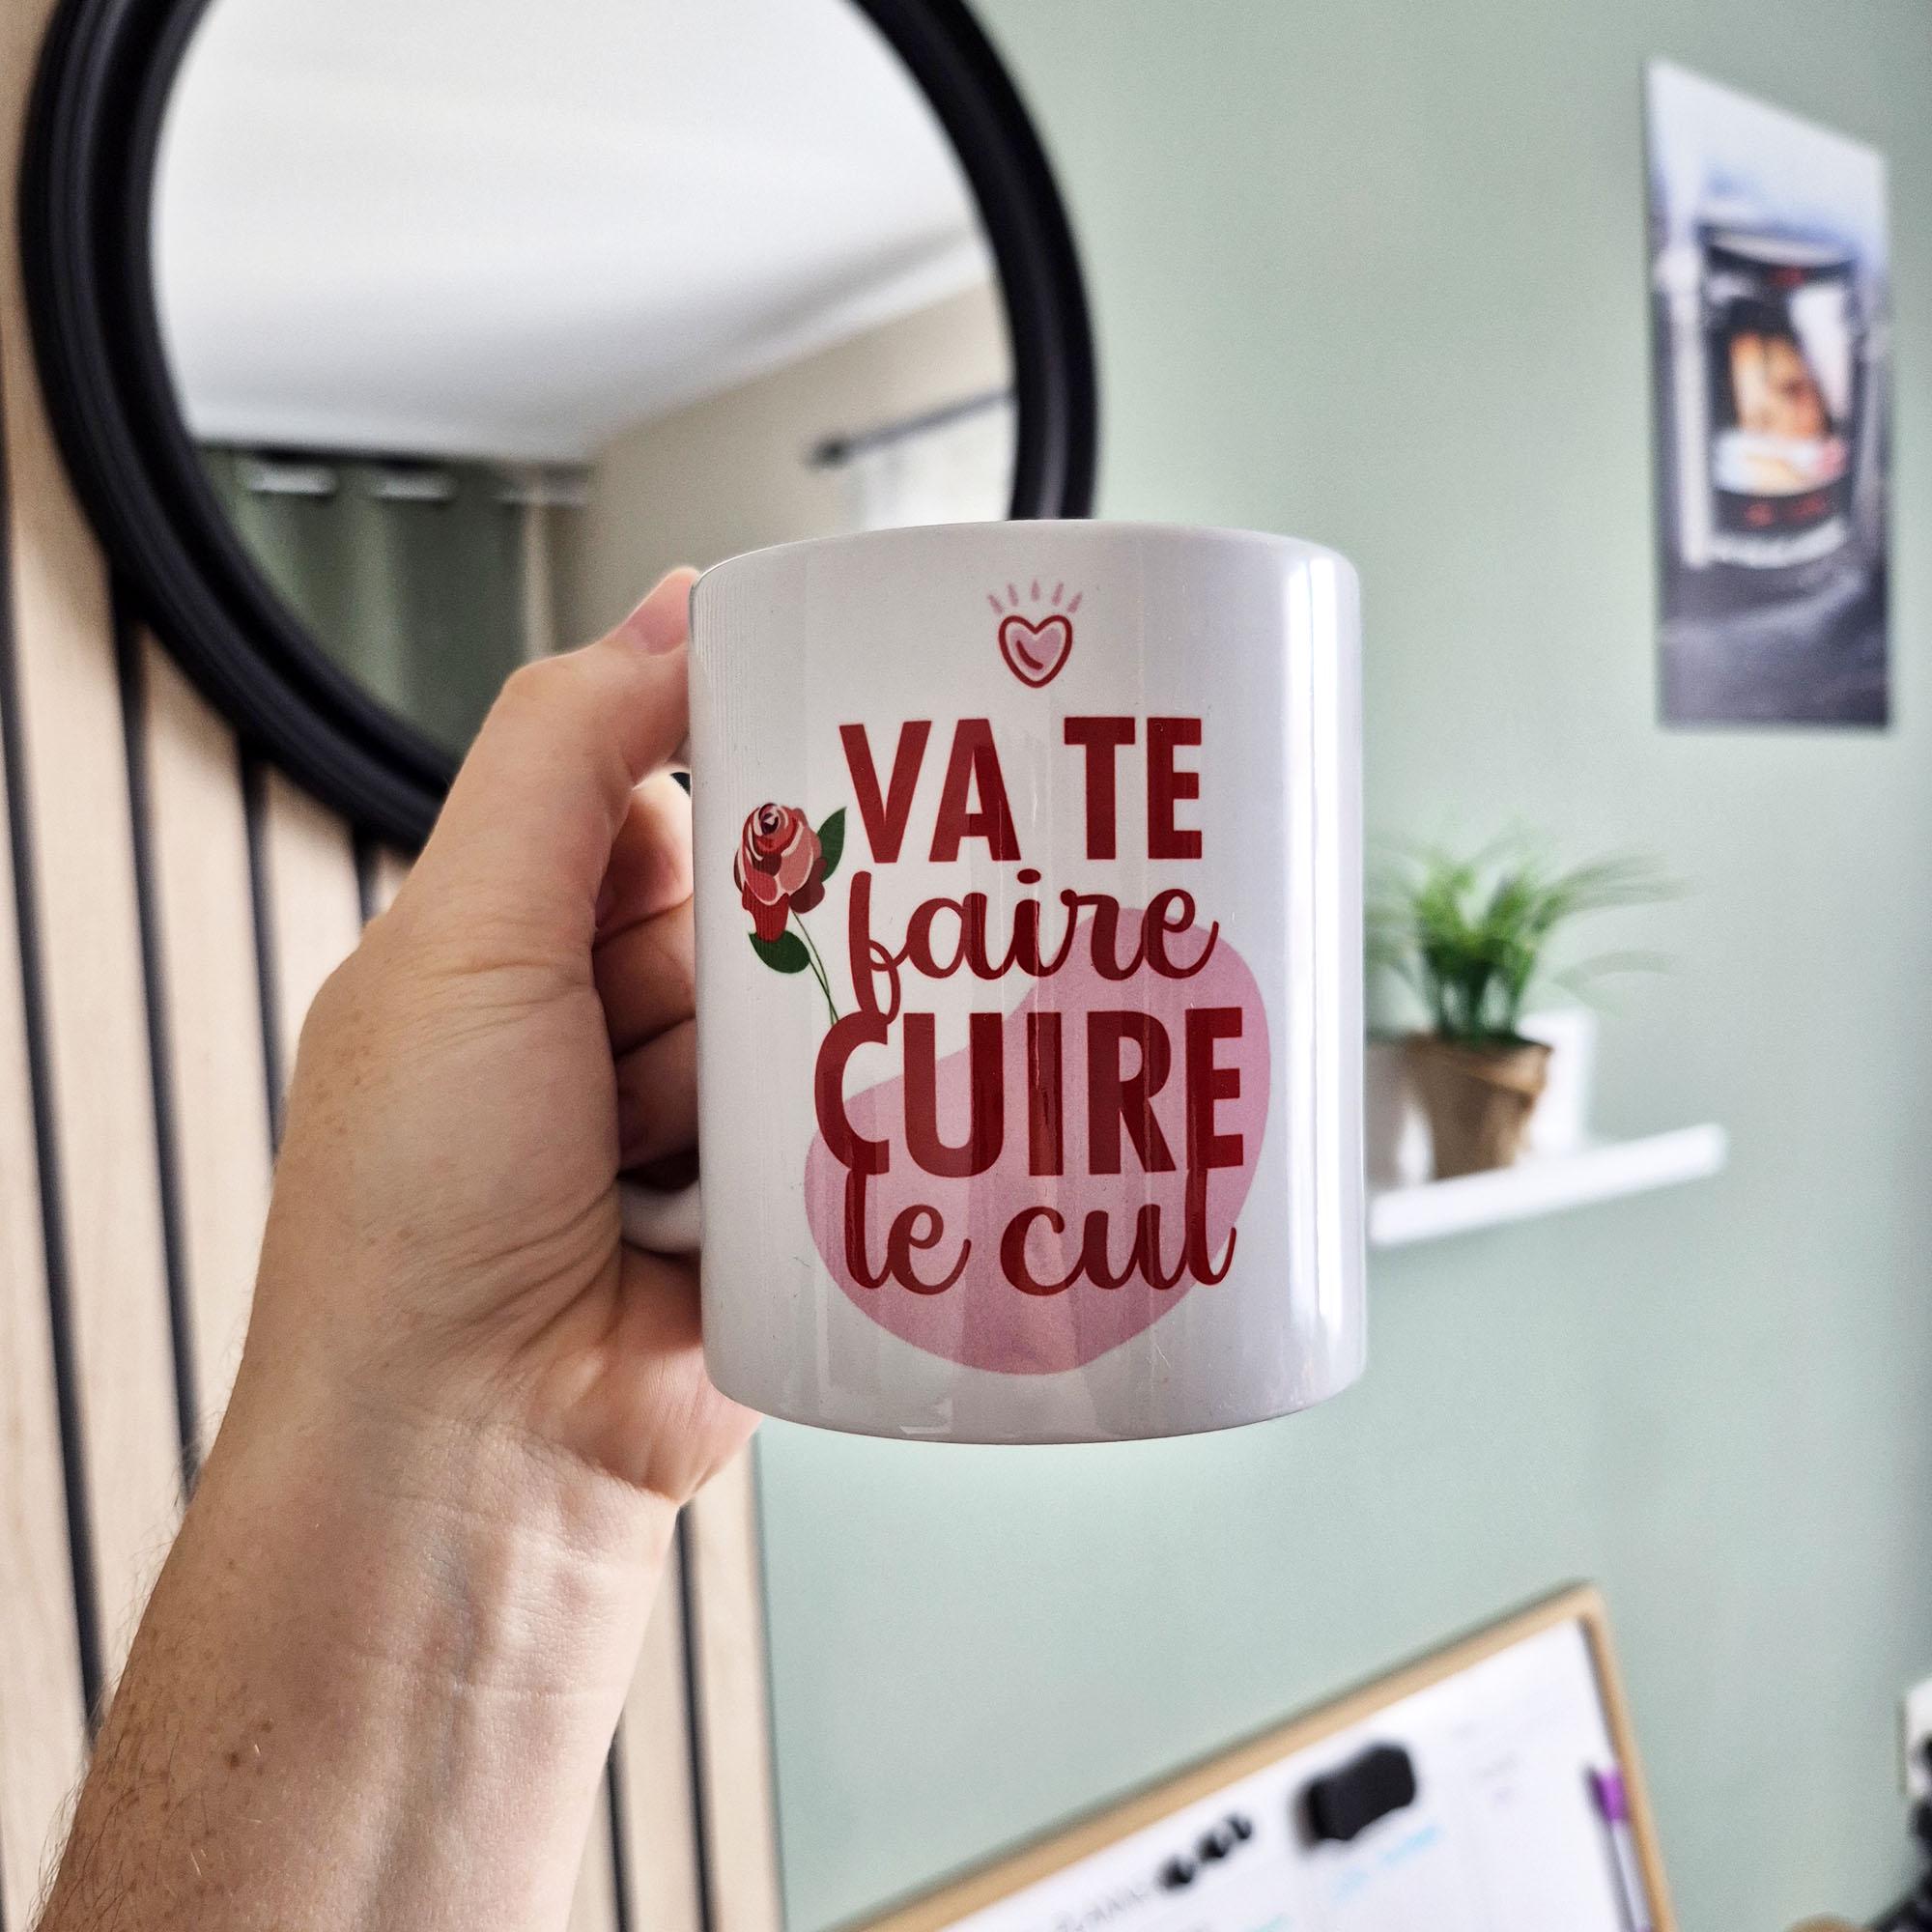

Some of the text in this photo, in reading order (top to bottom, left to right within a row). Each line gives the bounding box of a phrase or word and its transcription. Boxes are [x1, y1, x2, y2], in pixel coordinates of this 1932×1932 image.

[839, 716, 1203, 864] VA TE
[849, 869, 1219, 1025] faire
[814, 1007, 1244, 1179] CUIRE
[843, 1166, 1237, 1296] le cul
